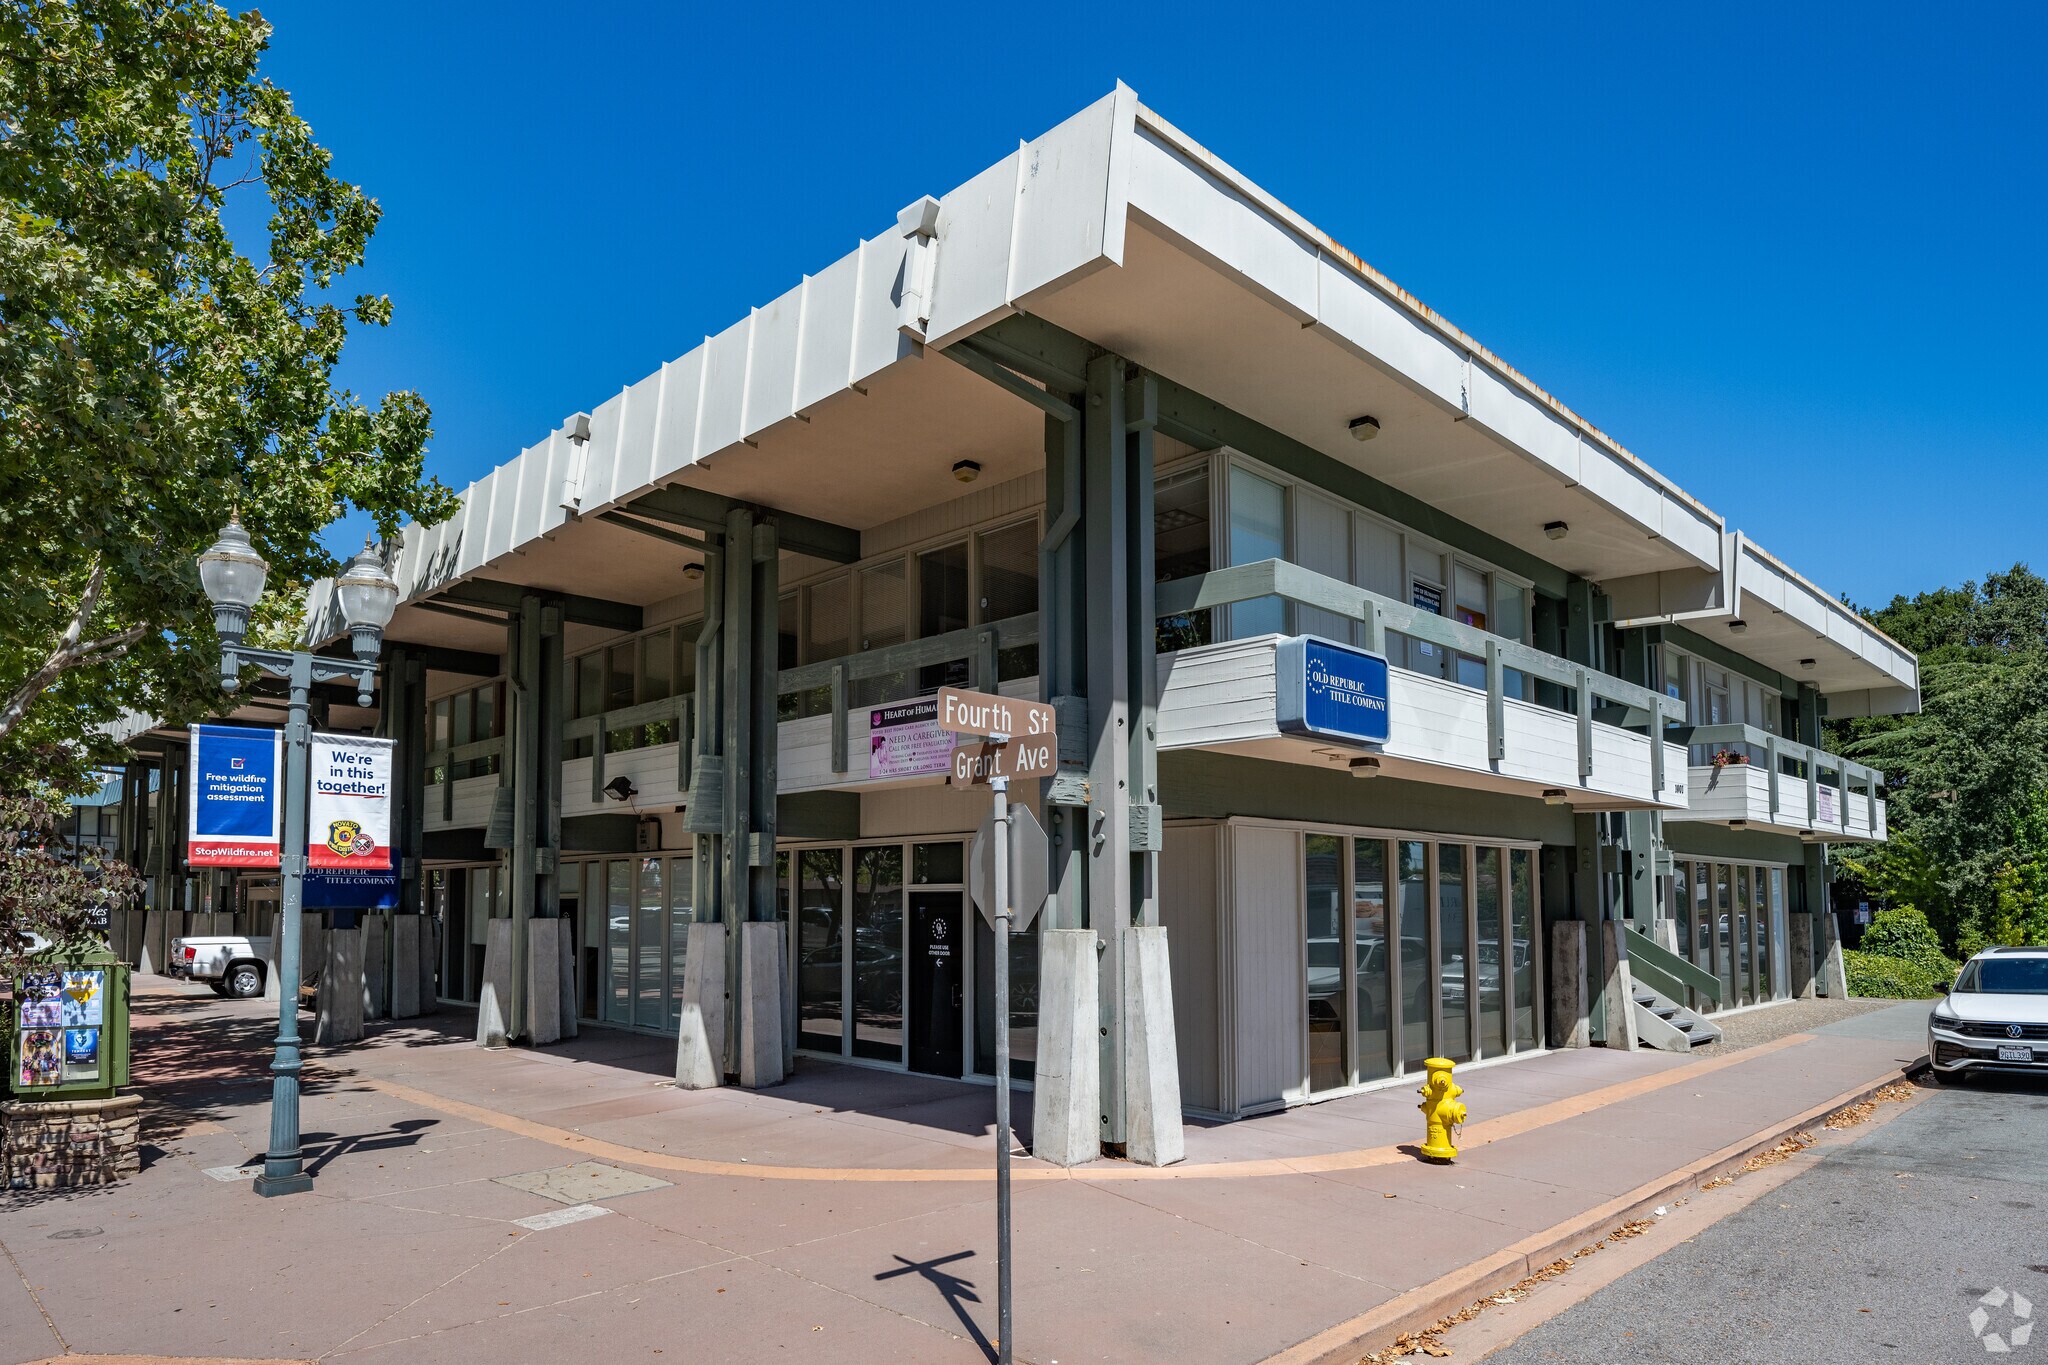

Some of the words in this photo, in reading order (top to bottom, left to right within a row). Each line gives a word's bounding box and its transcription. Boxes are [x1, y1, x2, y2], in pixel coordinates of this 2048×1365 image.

[1312, 671, 1328, 684] OLD
[1330, 675, 1366, 693] REPUBLIC
[1330, 690, 1352, 704] TITLE
[1352, 695, 1386, 712] COMPANY
[884, 709, 905, 719] HEART
[915, 704, 938, 714] HUMA
[946, 695, 1012, 732] Fourth
[1028, 709, 1049, 735] St
[888, 734, 906, 744] NEED
[332, 751, 372, 765] We're
[956, 748, 1001, 779] Grant
[1016, 744, 1049, 771] Ave
[206, 773, 227, 781] Free
[230, 775, 267, 783] wildfire
[330, 765, 343, 777] in
[347, 767, 374, 779] this
[210, 783, 262, 793] mitigation
[317, 780, 385, 794] together!
[195, 848, 273, 857] StopWildfire.net
